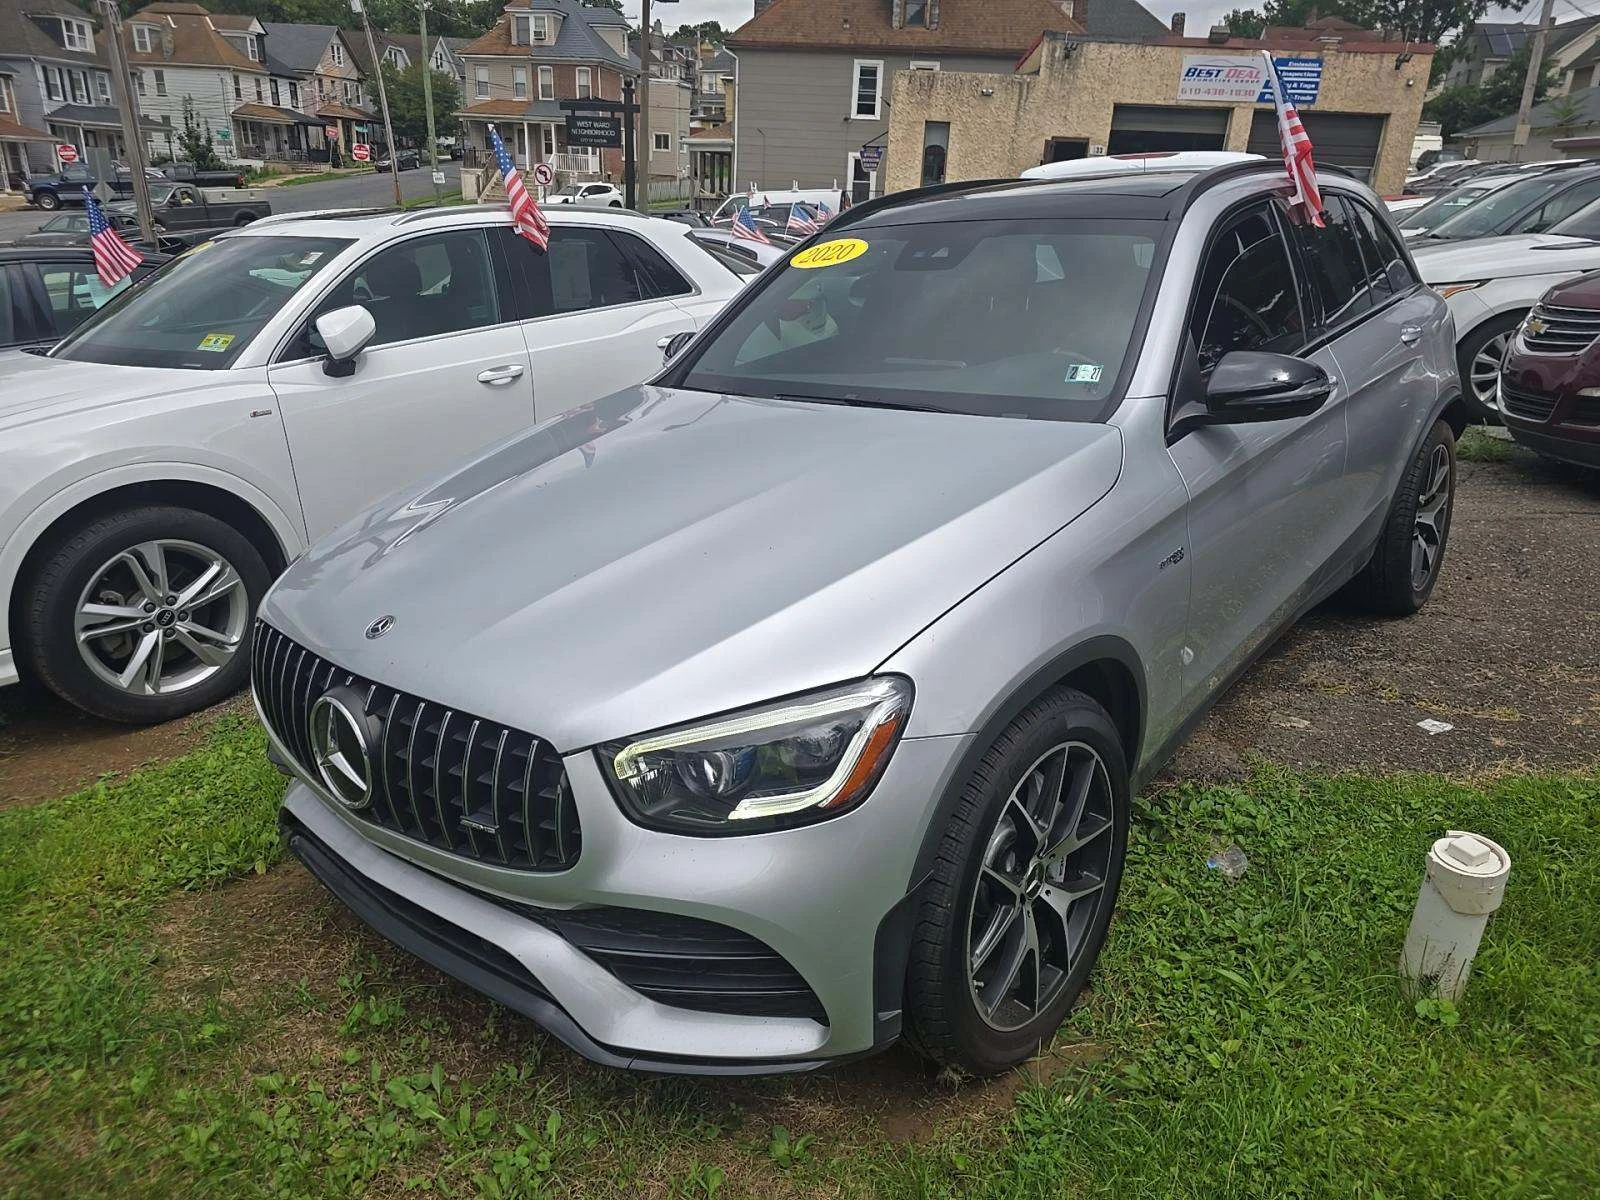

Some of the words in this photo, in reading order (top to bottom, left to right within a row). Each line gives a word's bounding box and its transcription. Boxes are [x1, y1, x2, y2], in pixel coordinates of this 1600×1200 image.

[1184, 67, 1224, 78] BEST
[1225, 68, 1261, 79] DEAL
[798, 243, 856, 264] 2020
[1090, 367, 1102, 381] 27
